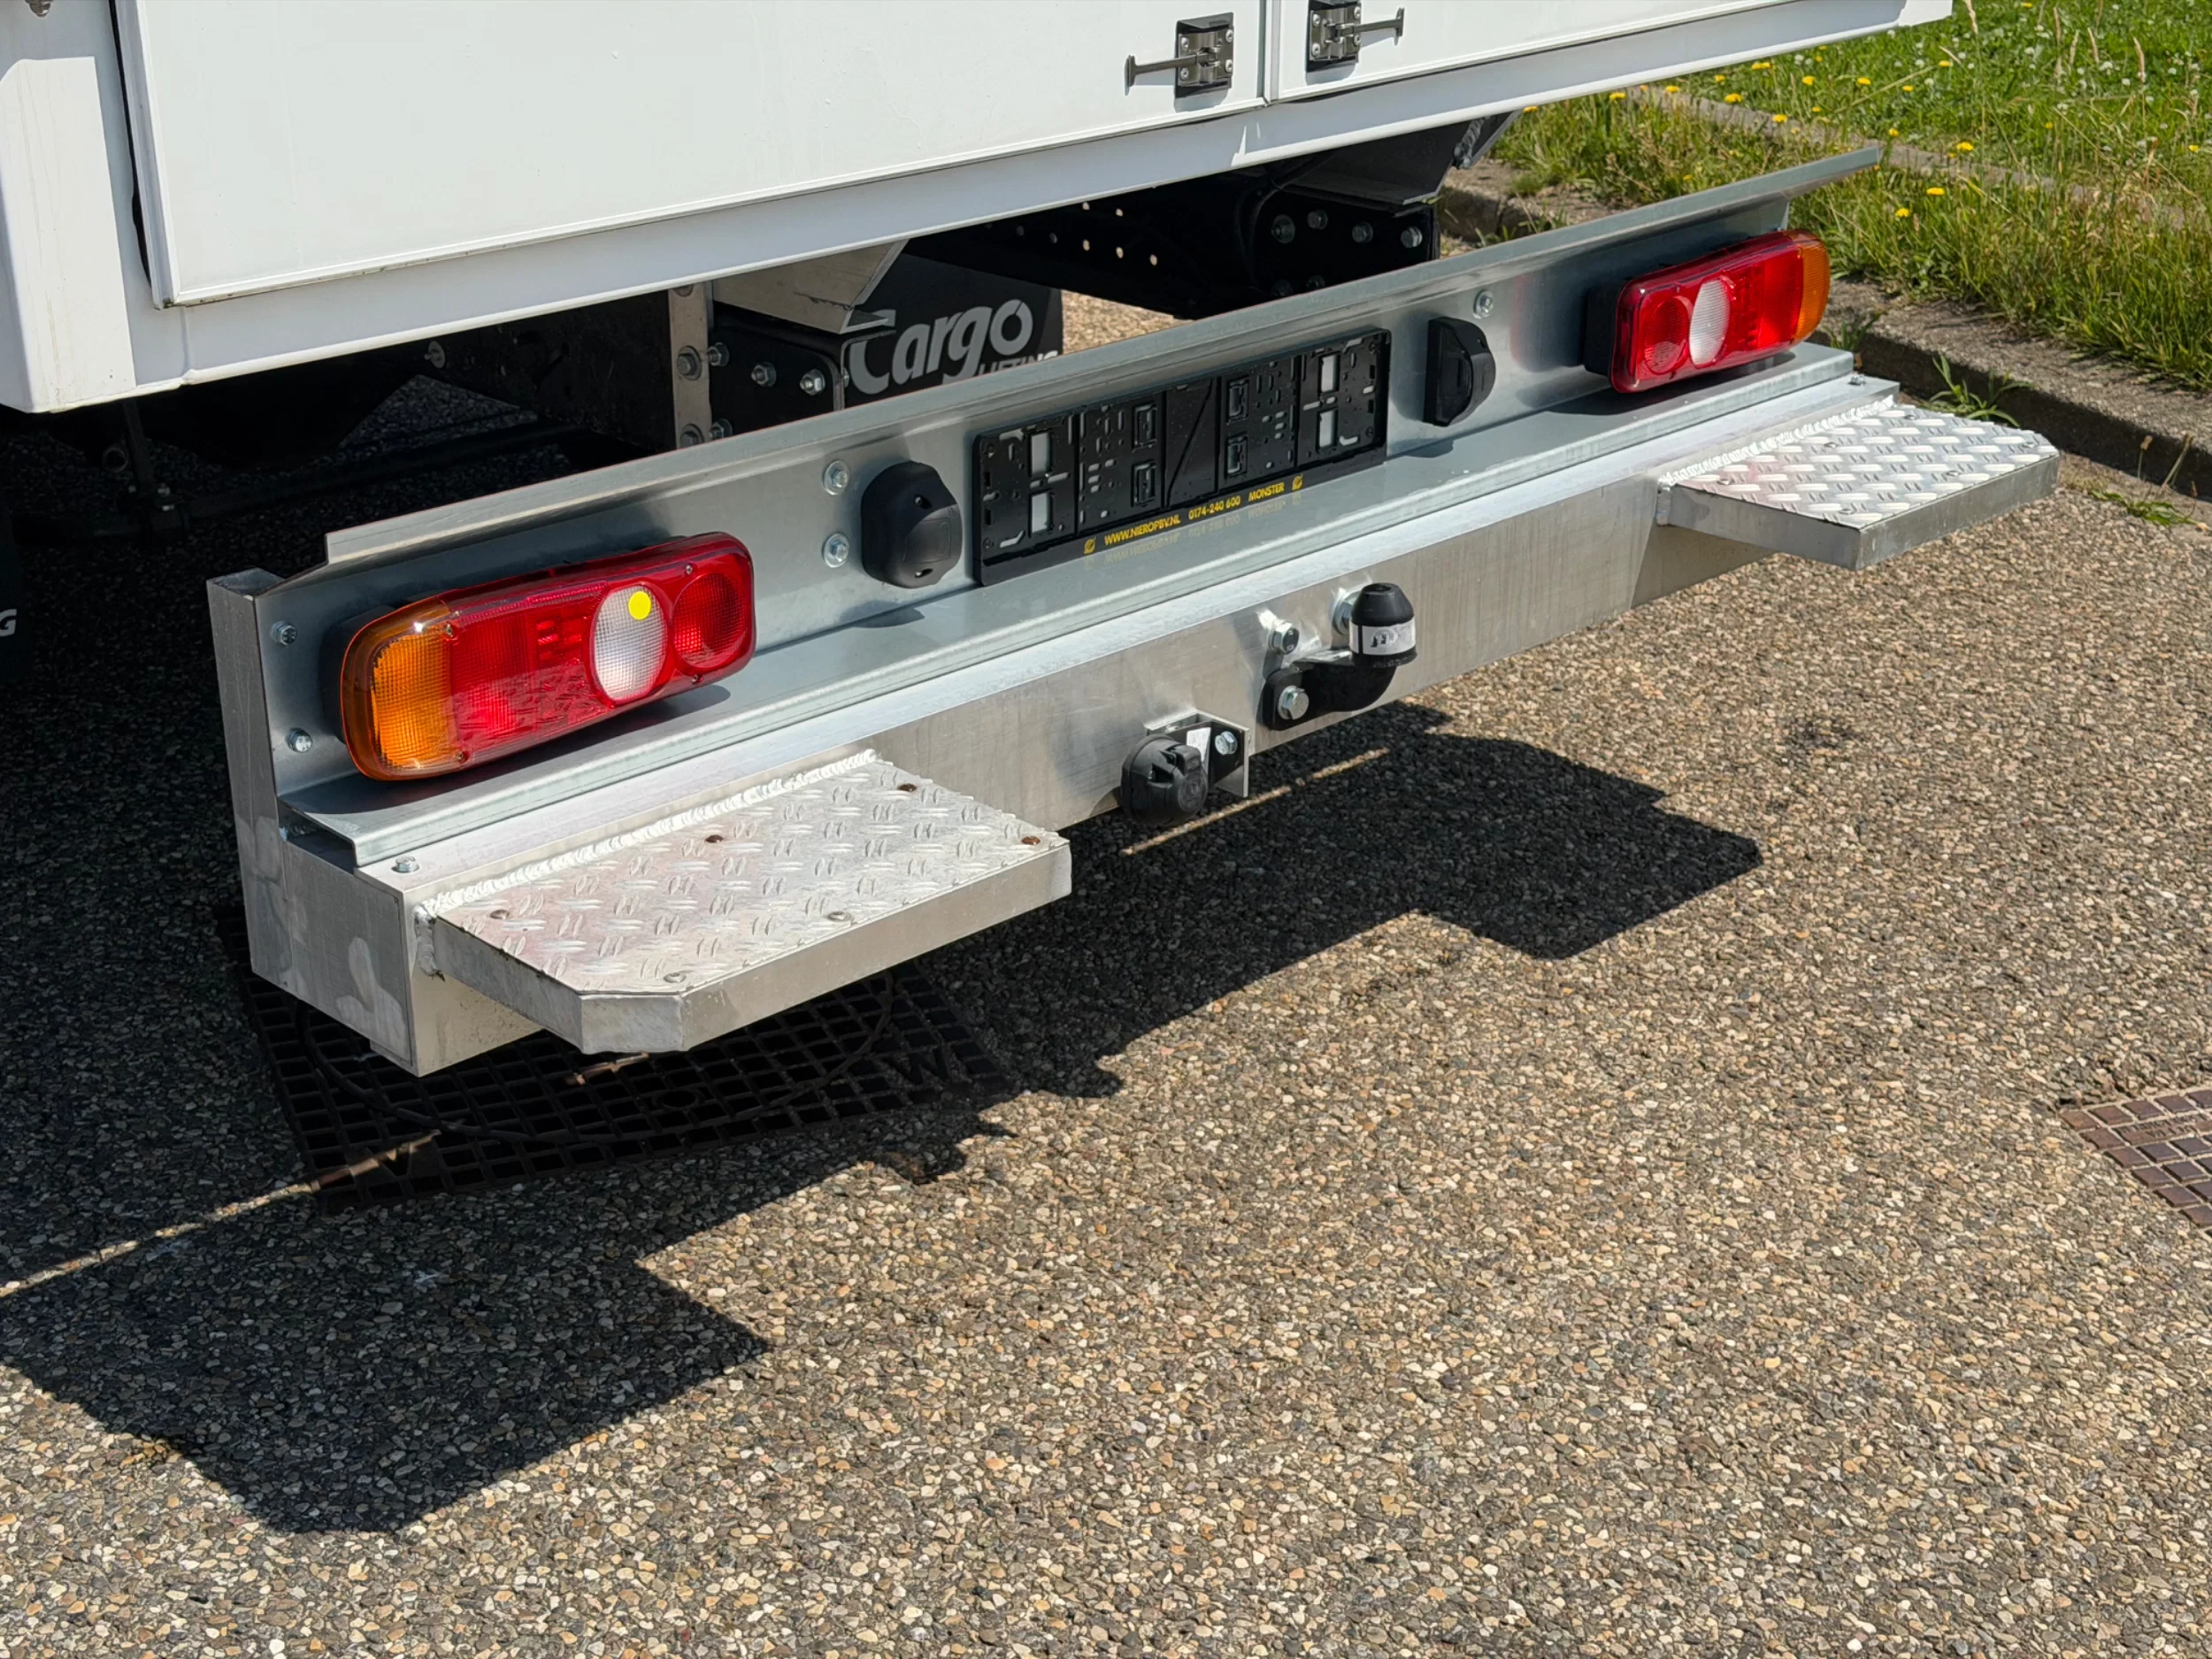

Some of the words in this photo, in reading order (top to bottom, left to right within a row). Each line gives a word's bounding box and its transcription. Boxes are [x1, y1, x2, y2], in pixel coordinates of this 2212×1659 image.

[849, 299, 1033, 395] Cargo
[1188, 500, 1225, 520] 0174-240
[1225, 495, 1241, 510] 600
[1248, 481, 1285, 503] MONSTER
